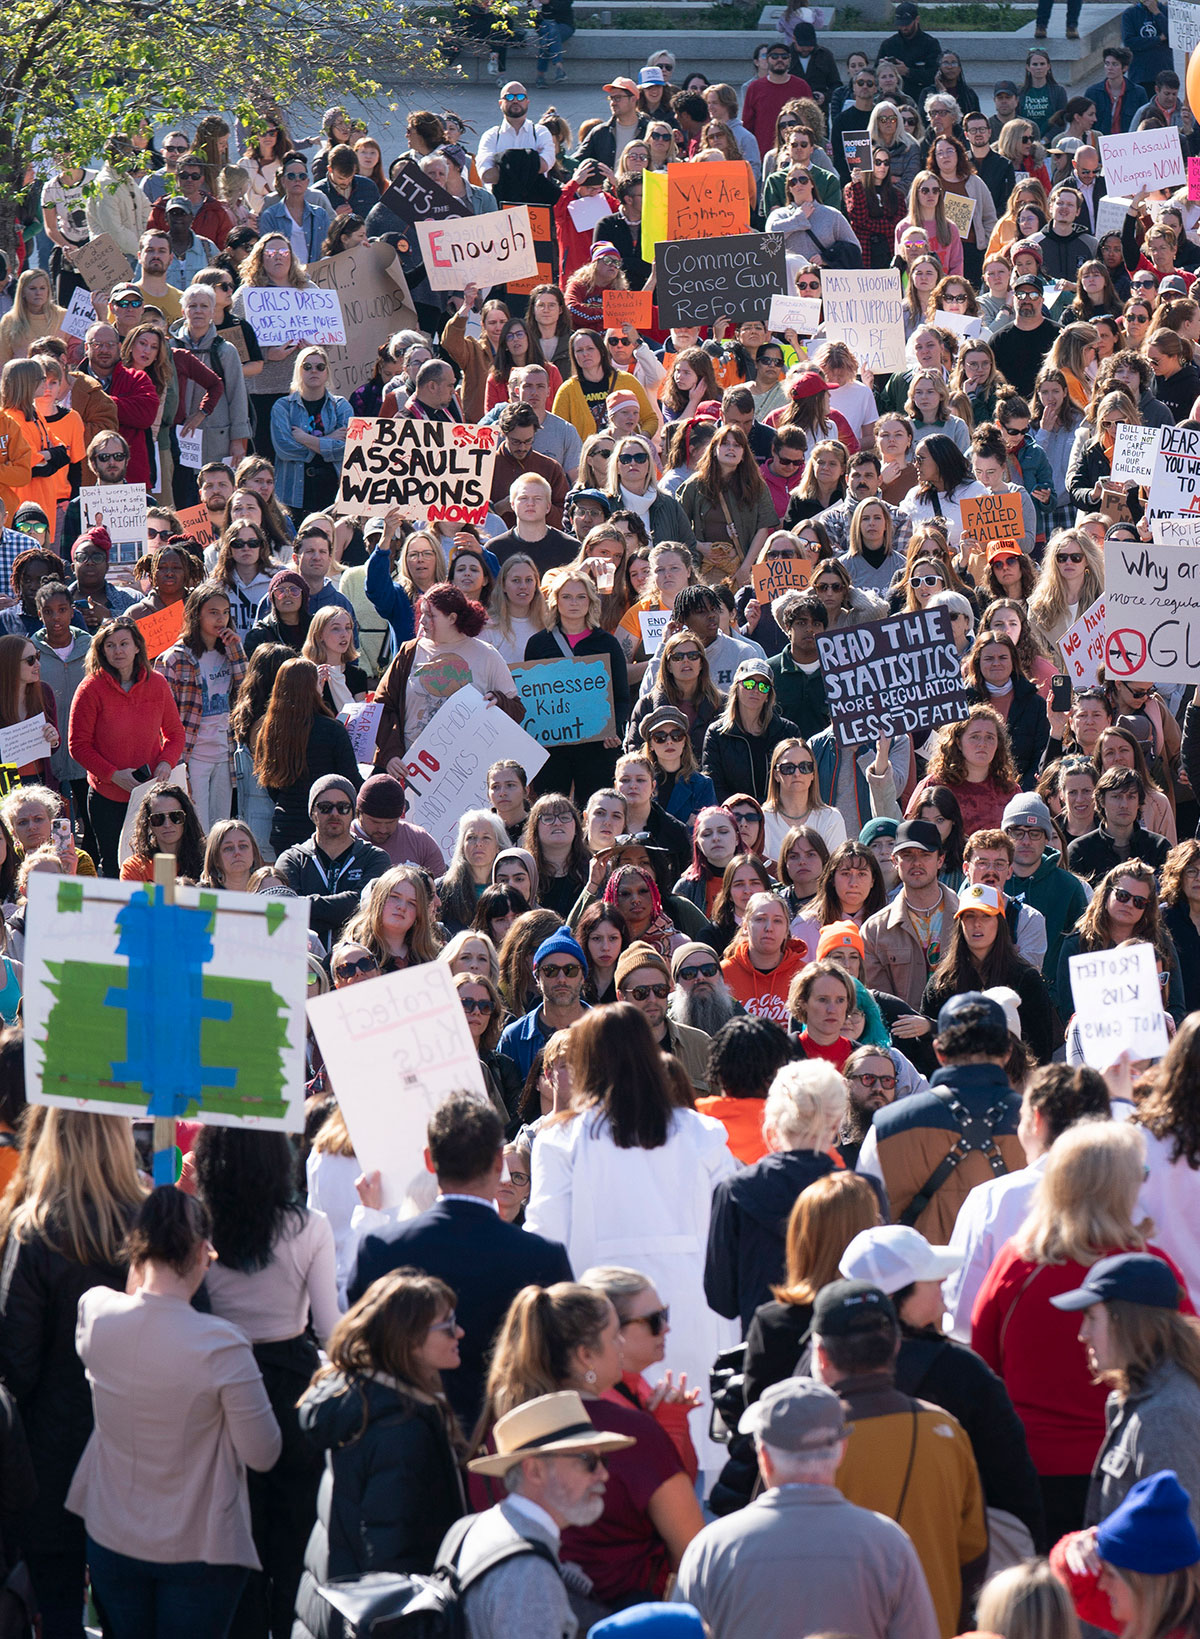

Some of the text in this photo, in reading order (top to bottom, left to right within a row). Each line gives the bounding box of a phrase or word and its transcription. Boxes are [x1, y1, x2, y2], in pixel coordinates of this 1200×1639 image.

[1024, 102, 1049, 111] Matter
[1025, 96, 1049, 105] People
[1027, 109, 1045, 117] Most
[1102, 134, 1178, 160] Ban Assault
[1106, 156, 1181, 186] Weapons NOW
[393, 174, 434, 214] IT'S
[672, 174, 741, 201] We Are
[432, 205, 449, 213] THE
[674, 205, 731, 226] Fighting
[428, 214, 526, 268] Enough
[664, 245, 763, 275] Common
[668, 268, 780, 296] Sense Gun
[826, 276, 850, 292] MASS
[294, 290, 335, 312] DRESS
[72, 302, 97, 322] kids
[861, 300, 901, 323] SUPPOSED
[250, 315, 339, 331] CODES ARE MORE
[313, 331, 345, 345] GUNS
[843, 327, 887, 349] TO BE
[374, 419, 445, 448] BAN
[1119, 433, 1154, 444] DOES NOT
[1122, 425, 1157, 436] BILL LEE
[1160, 426, 1199, 455] DEAR
[1121, 449, 1146, 459] ABOUT
[1126, 442, 1144, 451] CARE
[343, 446, 492, 477] ASSAULT
[1114, 462, 1152, 476] CHILDREN
[1164, 456, 1186, 473] YOU
[341, 475, 485, 507] WEAPONS
[1177, 476, 1196, 493] TO
[427, 501, 489, 526] NOW!
[975, 495, 1002, 512] YOU
[967, 507, 1018, 527] FAILED
[968, 523, 1021, 542] HALLIE
[766, 560, 793, 577] YOU
[1121, 550, 1170, 592] Why
[759, 574, 809, 591] FAILED
[1109, 592, 1153, 606] more
[138, 612, 175, 631] Protect
[647, 617, 667, 626] END
[1084, 604, 1106, 634] have
[816, 611, 946, 671] READ THE
[718, 670, 732, 684] H
[824, 643, 961, 700] STATISTICS
[1075, 660, 1085, 677] a
[535, 698, 571, 715] Kids
[830, 676, 967, 717] MORE REGULATION
[358, 704, 376, 733] FEAR
[839, 701, 971, 746] LESS DEATH
[438, 704, 476, 757] SCHOOL
[474, 723, 498, 749] IN
